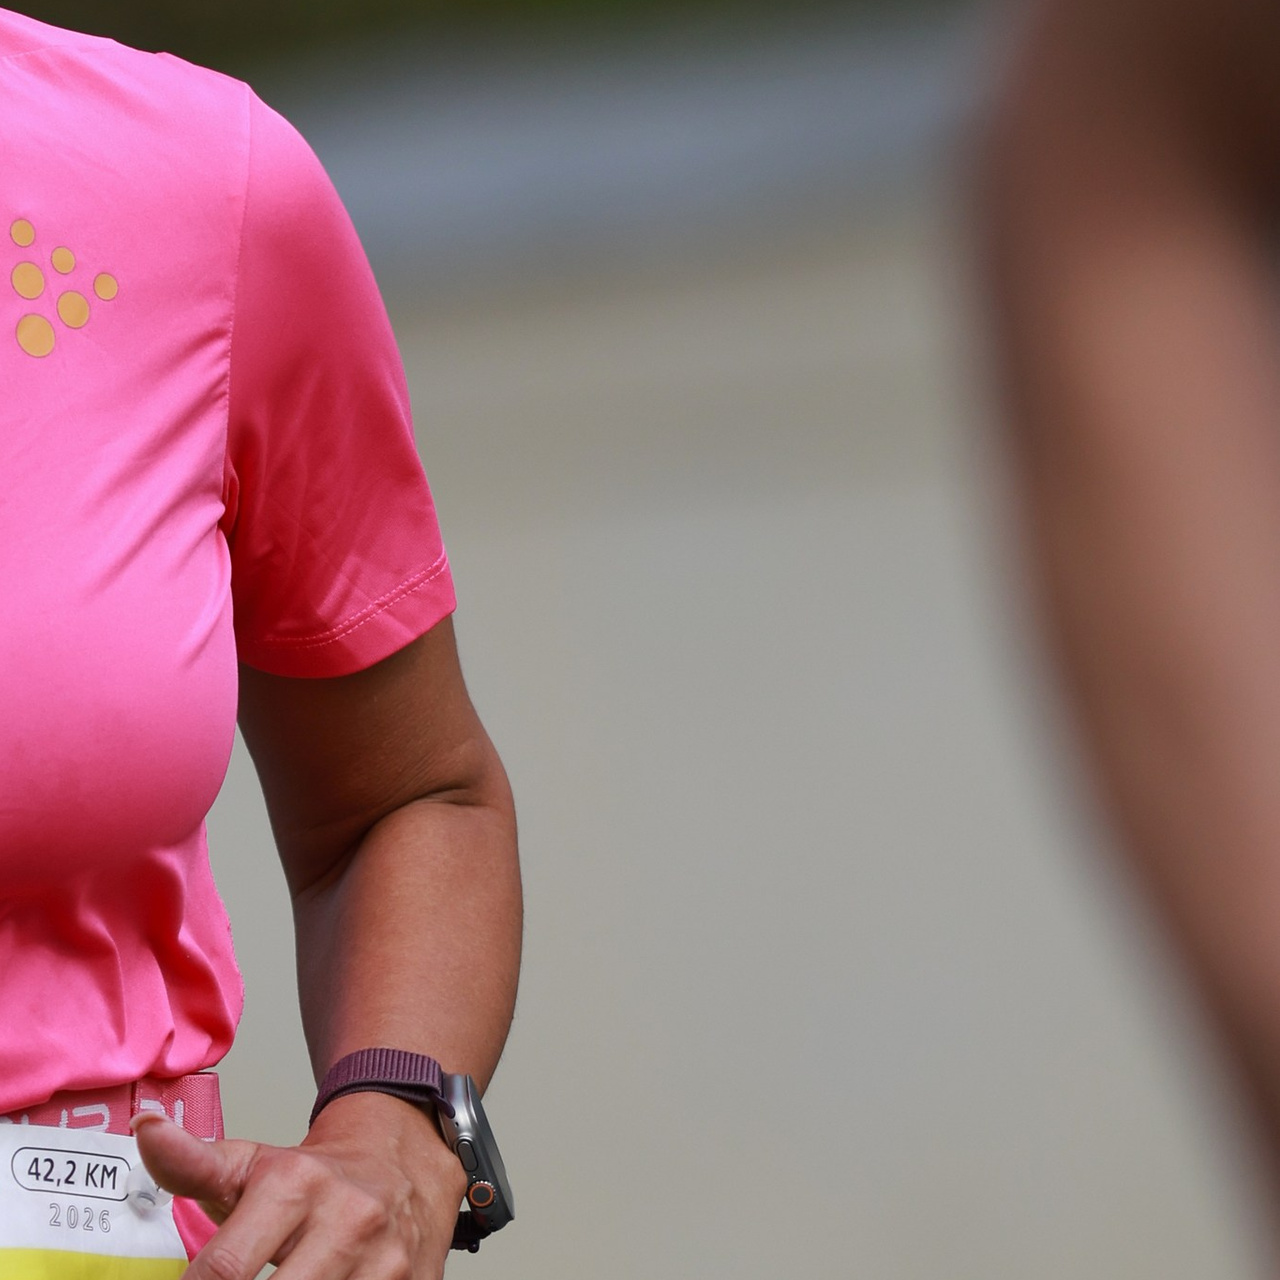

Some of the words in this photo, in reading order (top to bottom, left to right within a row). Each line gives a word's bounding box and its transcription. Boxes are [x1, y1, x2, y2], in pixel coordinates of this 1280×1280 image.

[27, 1157, 77, 1187] 42,2
[84, 1162, 118, 1190] КМ
[49, 1202, 112, 1233] 2026
